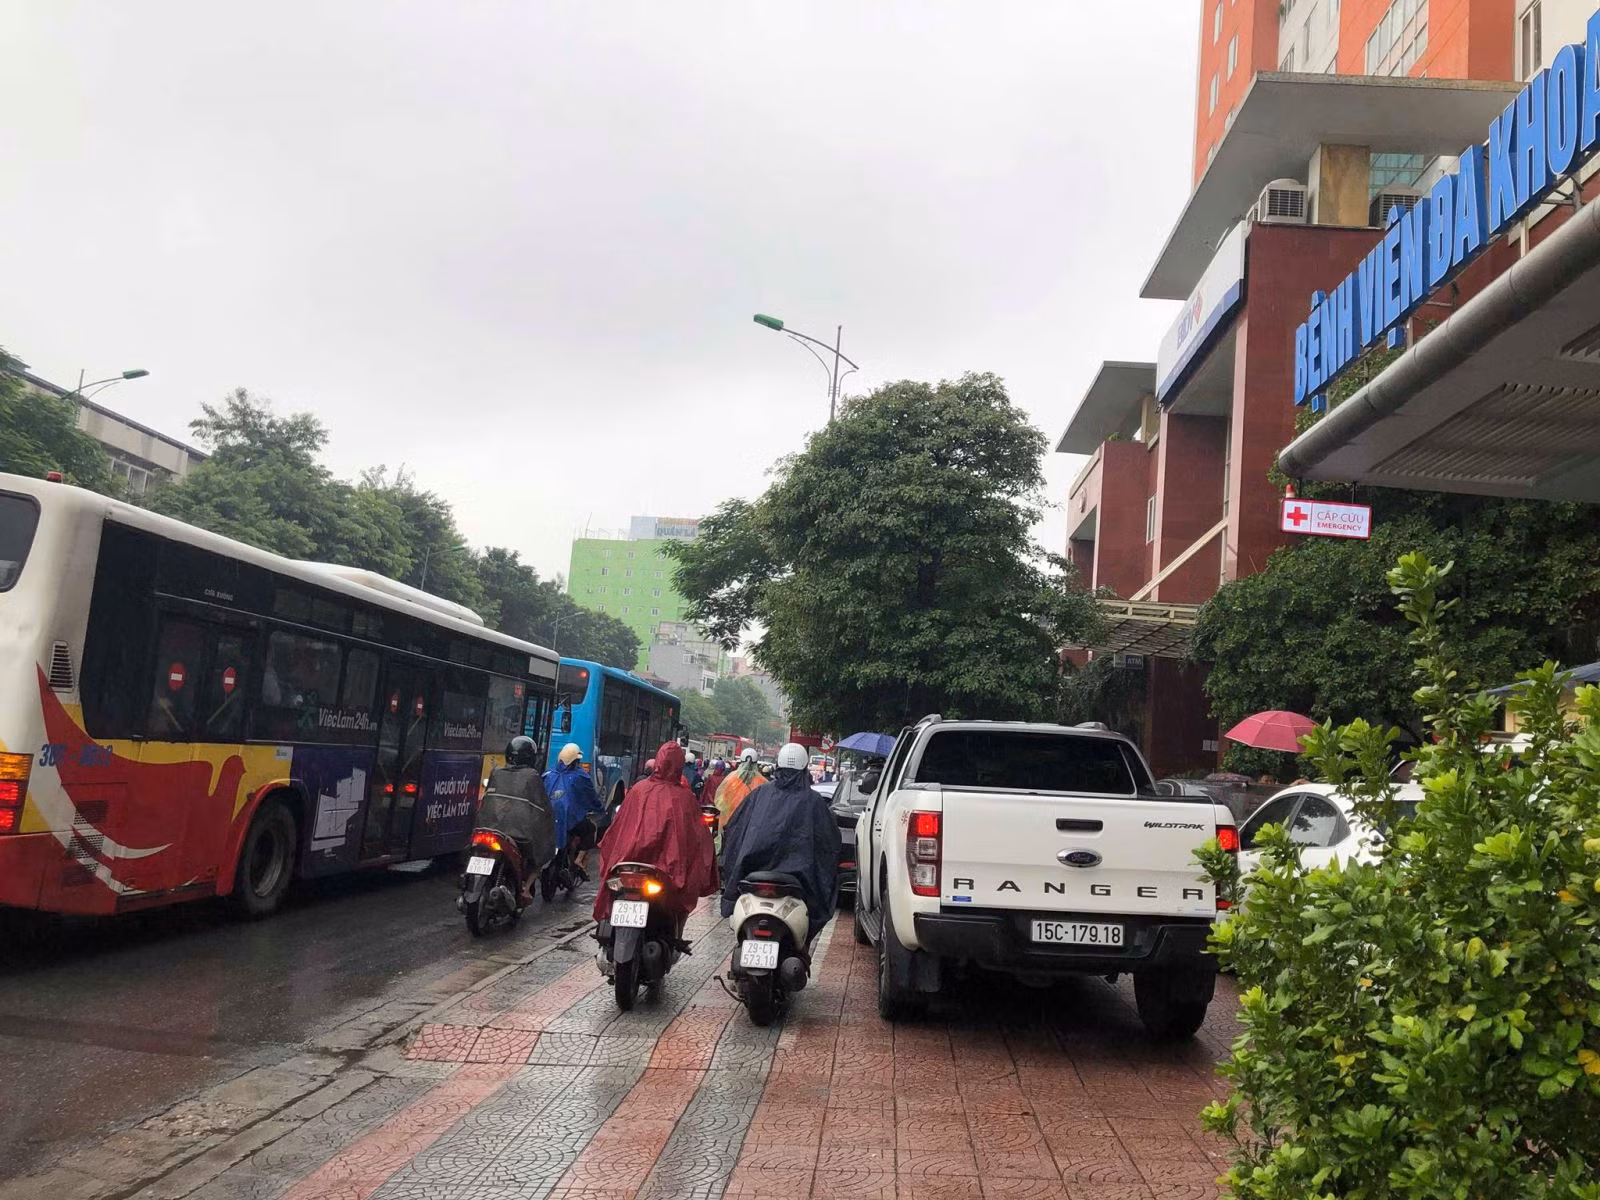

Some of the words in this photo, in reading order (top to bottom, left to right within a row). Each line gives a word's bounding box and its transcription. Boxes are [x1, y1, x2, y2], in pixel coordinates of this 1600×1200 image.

[1295, 289, 1354, 413] BỆNH
[1359, 198, 1424, 350] VIỆN
[1428, 145, 1481, 287] ĐA
[1317, 522, 1362, 531] EMERGENCY
[1143, 820, 1205, 831] WILDTRAK
[953, 877, 1204, 900] RANGER
[617, 902, 643, 914] 29-K1
[613, 913, 645, 926] 804.45
[1036, 922, 1121, 944] 15C-179.18
[747, 942, 773, 955] 29-C1
[743, 953, 775, 967] 573.10
